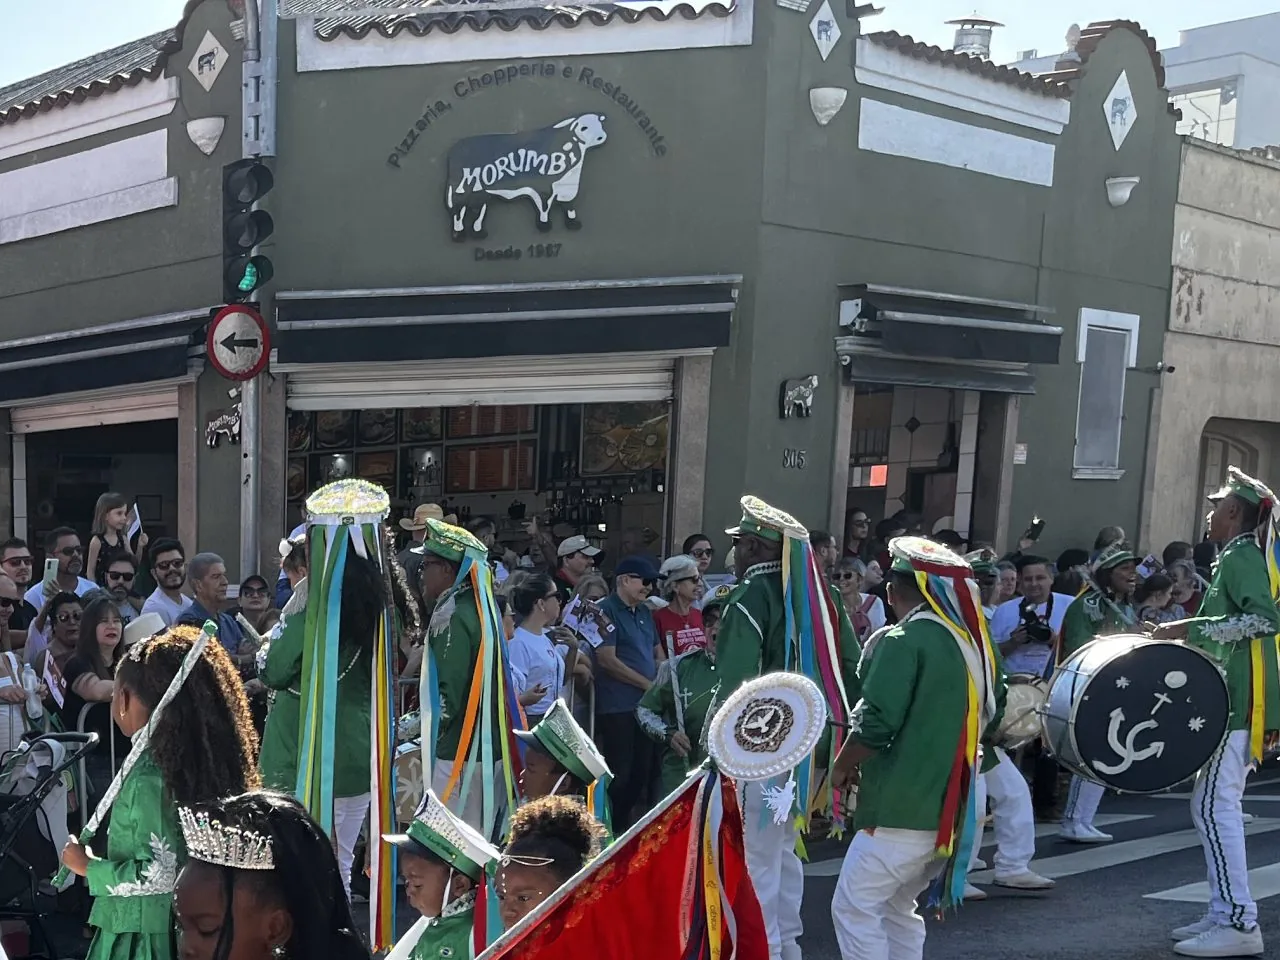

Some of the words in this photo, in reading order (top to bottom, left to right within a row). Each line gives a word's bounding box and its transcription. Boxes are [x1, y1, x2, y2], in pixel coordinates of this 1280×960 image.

[453, 61, 556, 98] Chopperia
[562, 65, 574, 80] e
[579, 67, 667, 158] Restaurante
[474, 244, 523, 262] Desde
